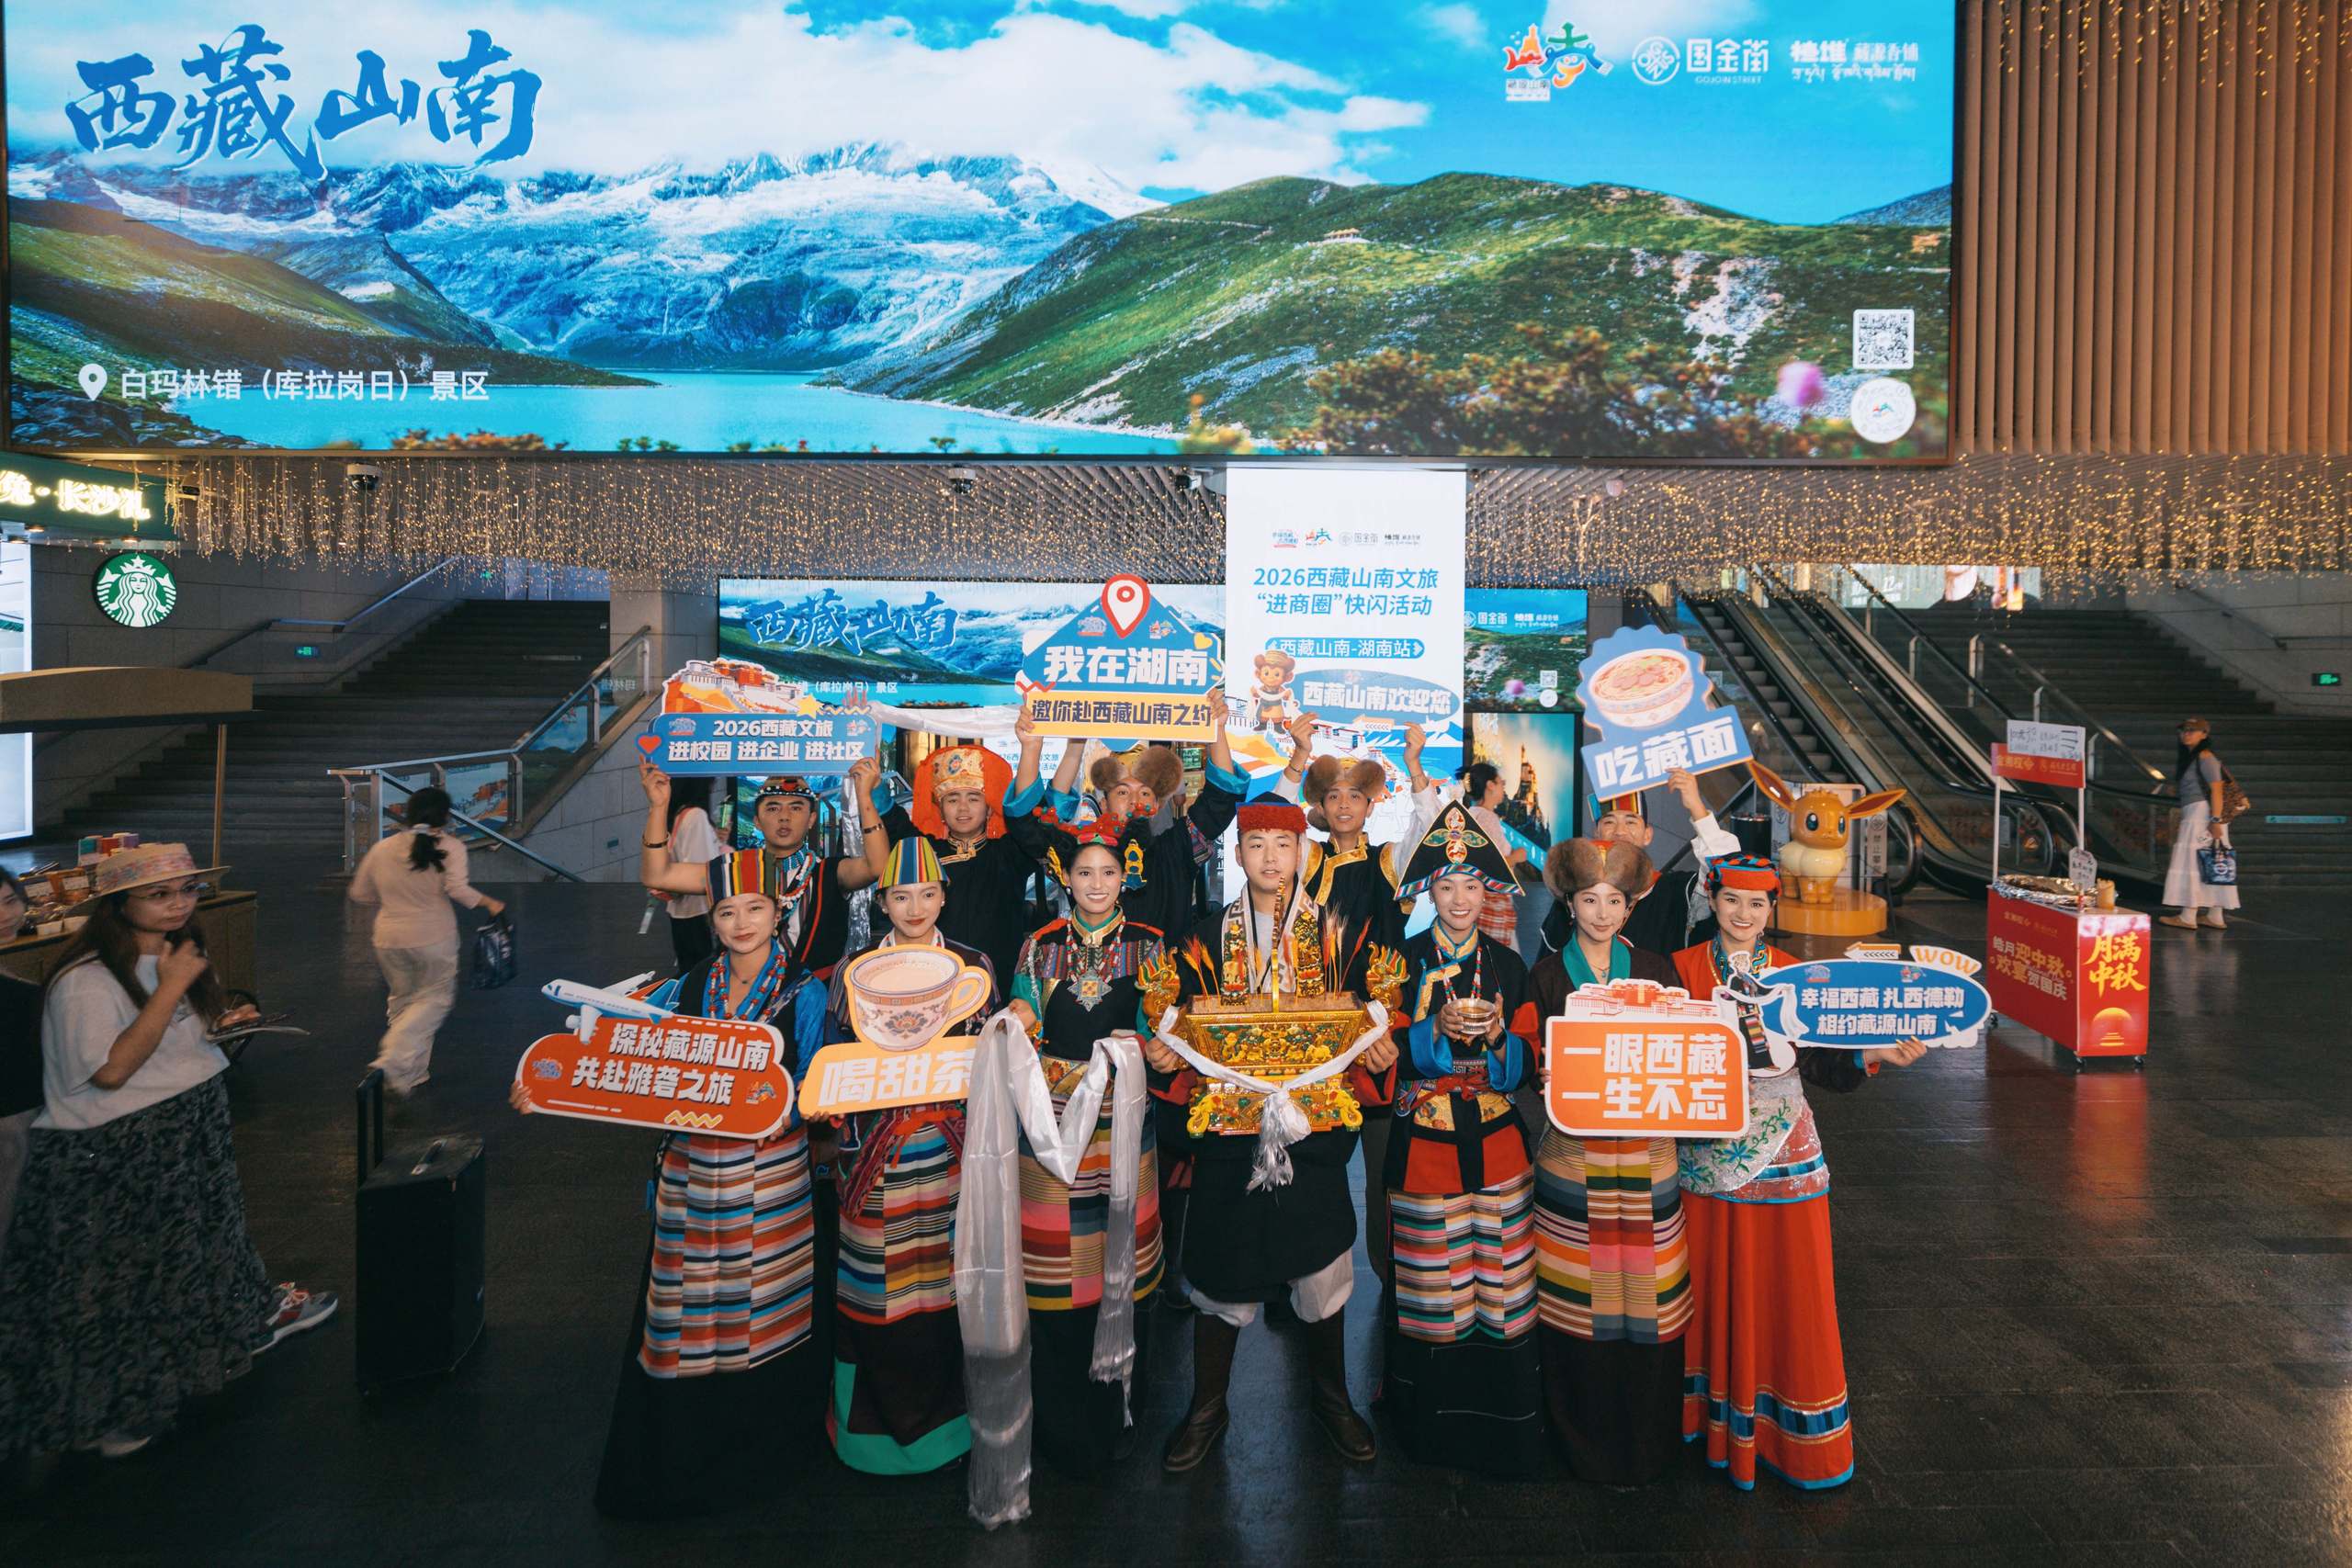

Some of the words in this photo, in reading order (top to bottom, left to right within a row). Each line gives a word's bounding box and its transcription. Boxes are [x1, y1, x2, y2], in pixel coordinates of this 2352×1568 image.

[65, 24, 543, 181] 西藏山南
[121, 368, 489, 401] 白玛林错（库拉岗日）景区
[1253, 567, 1439, 590] 2026西藏山南文旅
[746, 588, 958, 656] 西藏山南
[1043, 645, 1208, 686] 我在湖南
[1281, 639, 1411, 658] 西藏山南-湖南站
[1032, 699, 1212, 727] 邀你赴西藏山南之约
[1303, 681, 1452, 715] 西藏山南欢迎您
[713, 720, 833, 737] 2026西藏文旅
[668, 740, 731, 761] 进校园
[737, 740, 799, 761] 进企业
[805, 740, 865, 761] 进社区
[1595, 716, 1738, 788] 吃藏面
[1801, 987, 1879, 1010] 幸福西藏
[1883, 987, 1964, 1010] 扎西德勒
[1817, 1013, 1938, 1036] 相约藏源山南
[608, 1022, 773, 1072] 探秘藏源山南
[1564, 1033, 1727, 1075] 一眼西藏
[818, 1048, 977, 1107] 喝甜茶
[1562, 1077, 1727, 1121] 一生不忘
